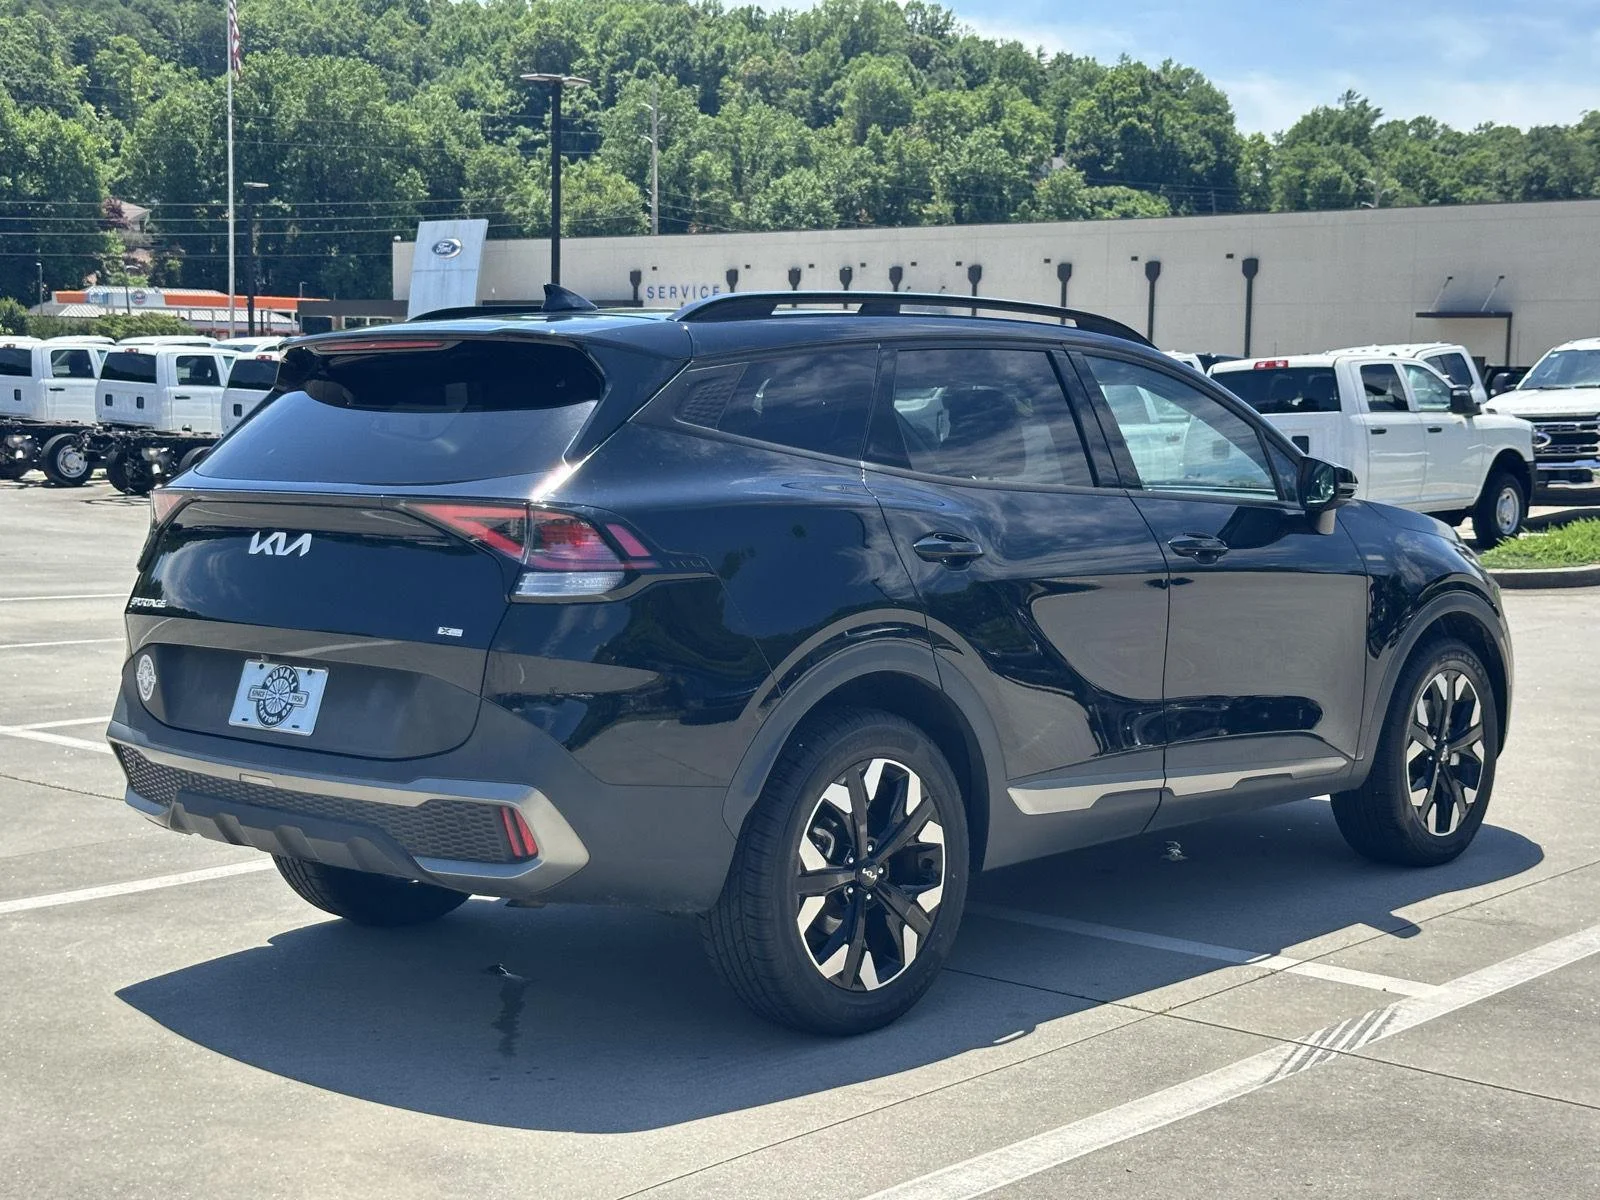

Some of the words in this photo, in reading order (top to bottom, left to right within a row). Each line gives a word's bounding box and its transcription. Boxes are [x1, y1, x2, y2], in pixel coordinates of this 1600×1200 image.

[647, 286, 720, 299] SERVICE
[248, 531, 312, 557] KIA
[265, 668, 298, 690] DUVALL
